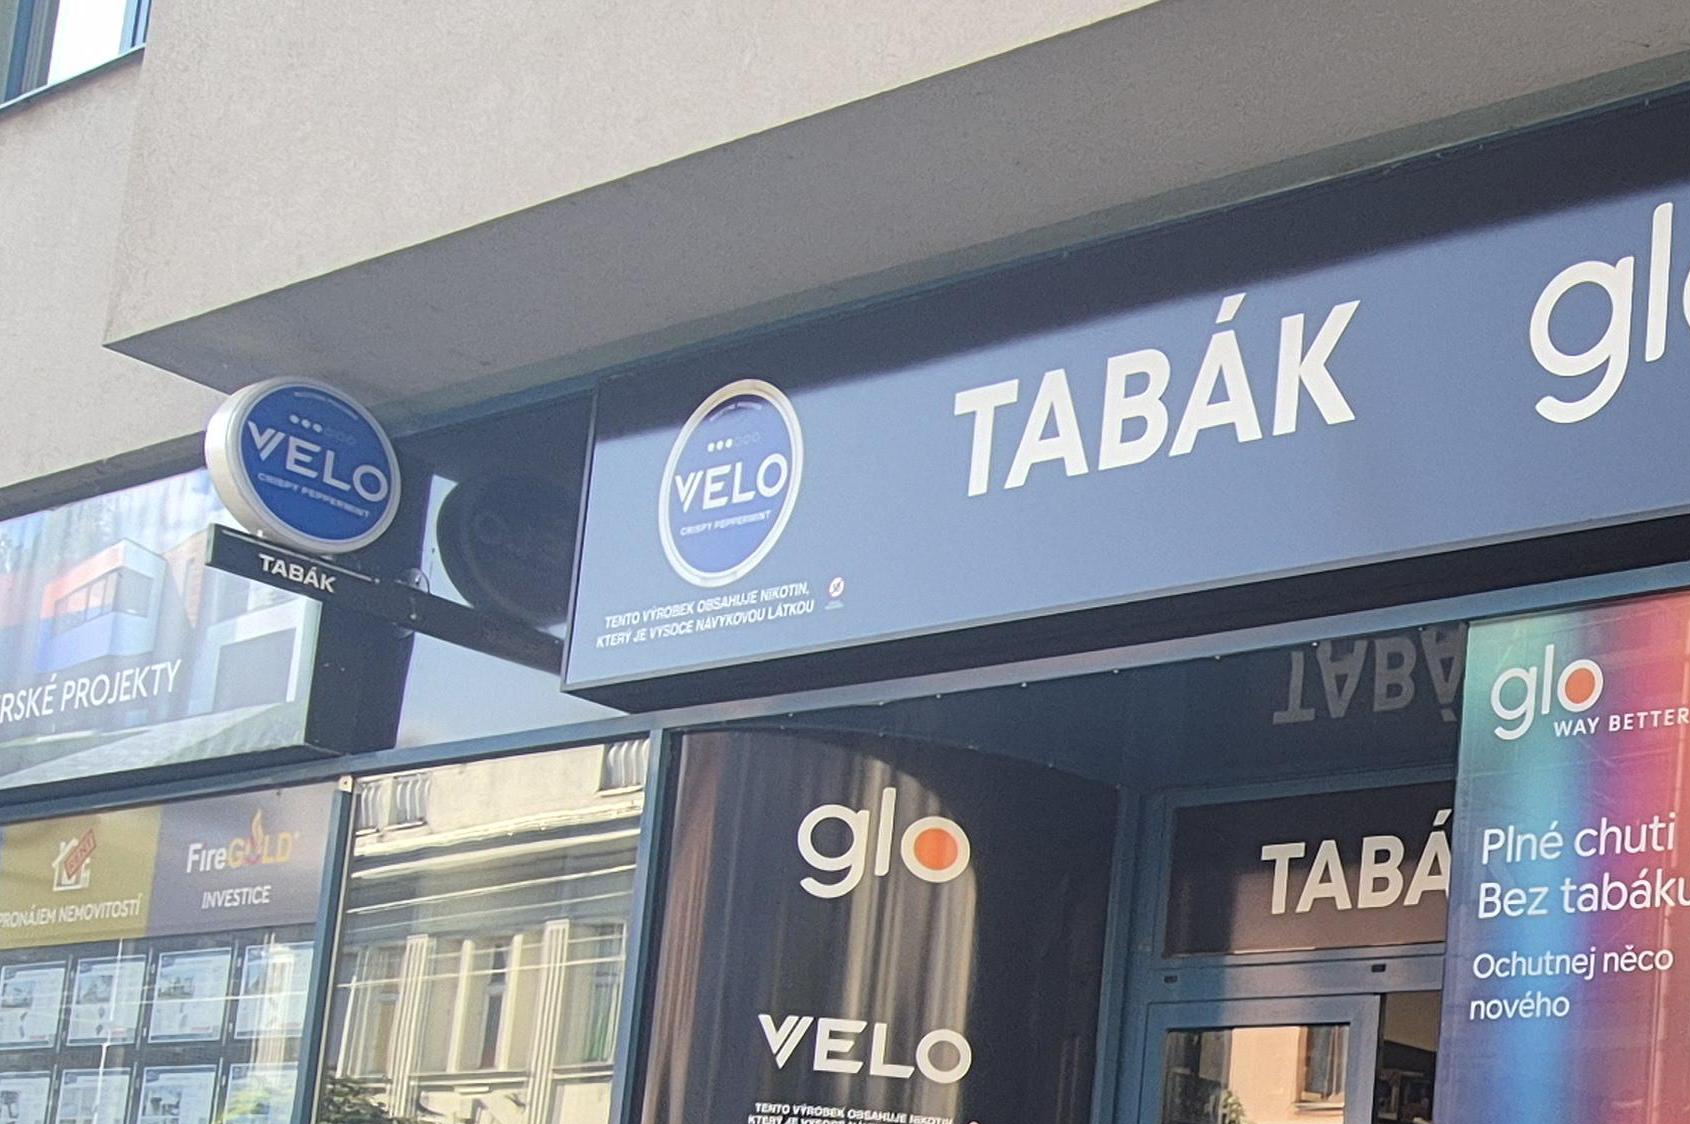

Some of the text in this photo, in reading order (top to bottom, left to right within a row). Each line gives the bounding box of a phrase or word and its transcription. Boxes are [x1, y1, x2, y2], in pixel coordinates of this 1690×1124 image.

[953, 293, 1361, 498] TABÁK
[248, 420, 389, 502] VELO
[675, 453, 789, 513] VELO
[259, 553, 336, 593] TABÁK
[596, 600, 815, 648] KTERÝ JE VYSOCE NÁVYKOVOU LÁTKOU
[605, 613, 640, 629] TENTO
[643, 601, 695, 621] VÝROBEK
[697, 590, 758, 613] OBSAHUJE
[61, 659, 183, 712] PROJEKTY
[1490, 644, 1603, 740] glo
[1554, 716, 1599, 737] WAY
[798, 787, 970, 898] glo
[1261, 809, 1452, 914] TABÁ
[1482, 812, 1677, 865] Plné chuti
[59, 893, 143, 922] NEMOVITOSTÍ
[202, 885, 271, 909] INVESTICE
[1478, 882, 1549, 919] Bez
[1473, 945, 1675, 982] Ochutnej něco
[1470, 991, 1570, 1021] nového
[758, 1014, 972, 1084] VELO
[755, 1102, 790, 1115] TENTO
[793, 1103, 845, 1119] VÝROBEK
[847, 1108, 906, 1124] OBSAHUJE
